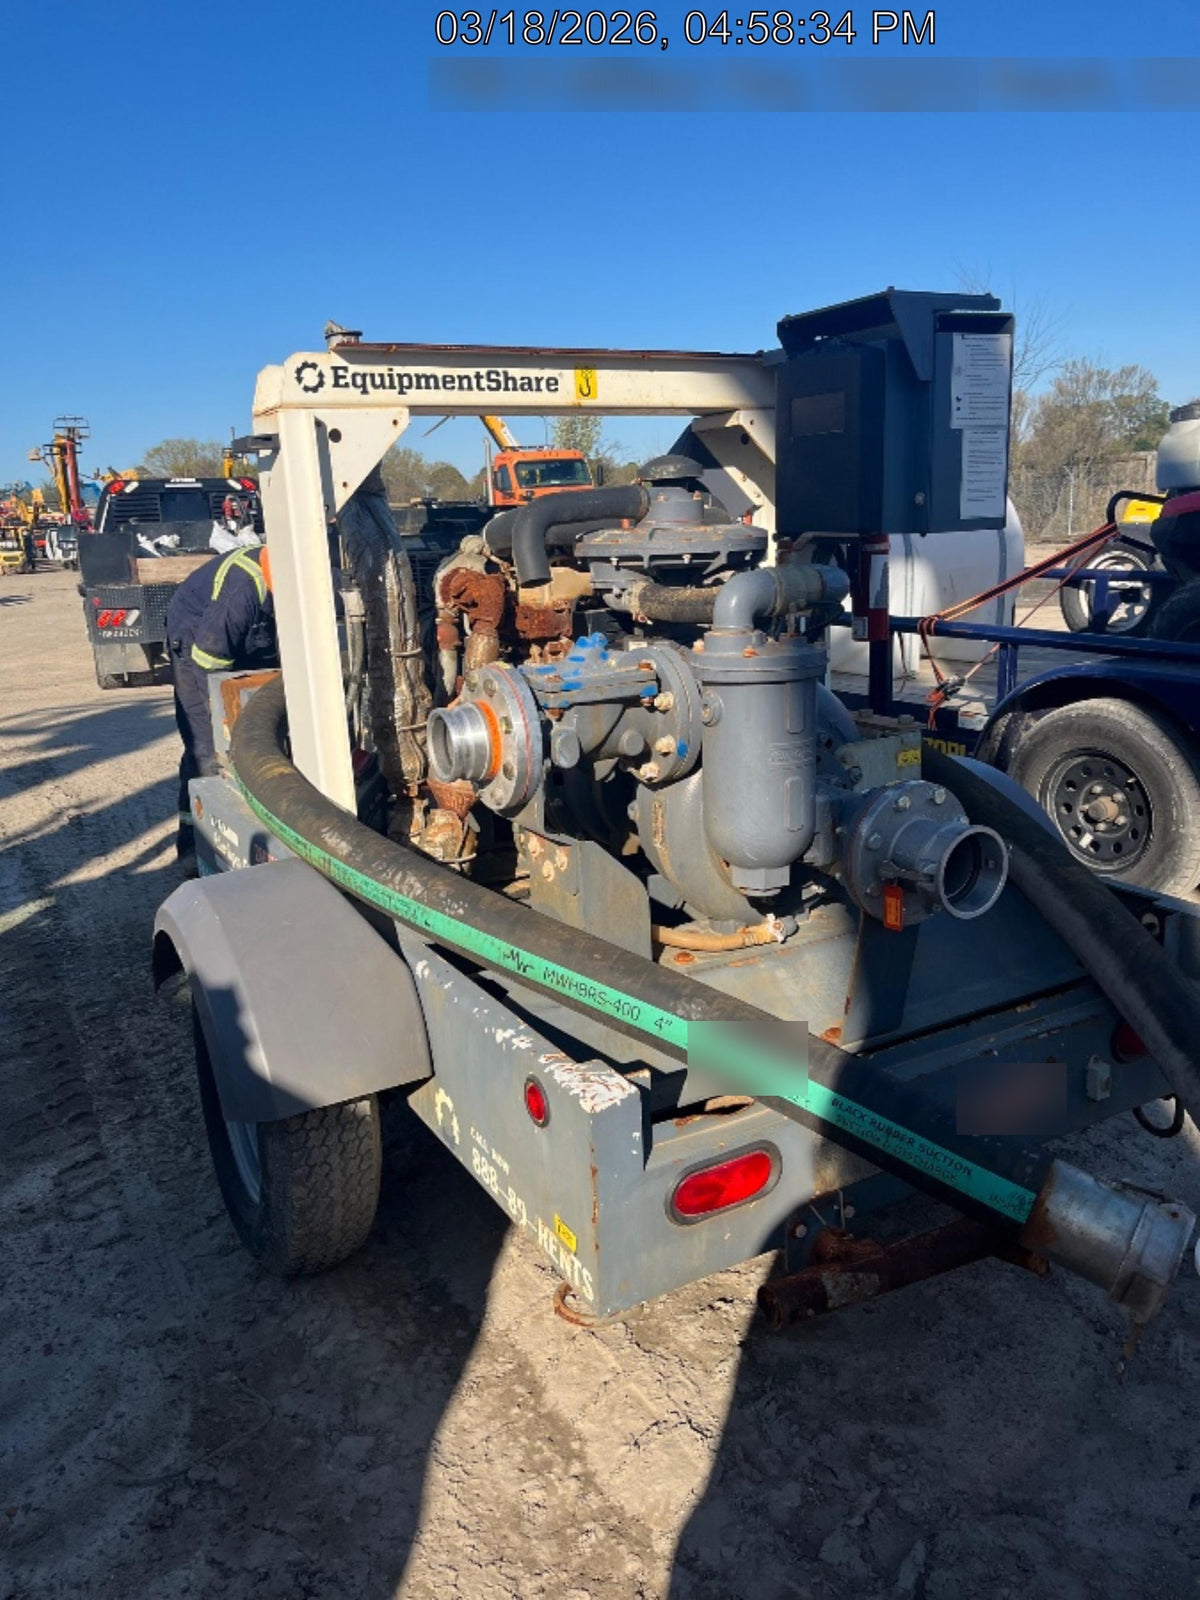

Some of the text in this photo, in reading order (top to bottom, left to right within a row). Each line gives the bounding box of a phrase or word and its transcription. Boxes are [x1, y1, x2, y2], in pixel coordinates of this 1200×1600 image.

[330, 365, 560, 395] EquipmentShare
[831, 1097, 973, 1177] BLACK RUBBER SUCTION
